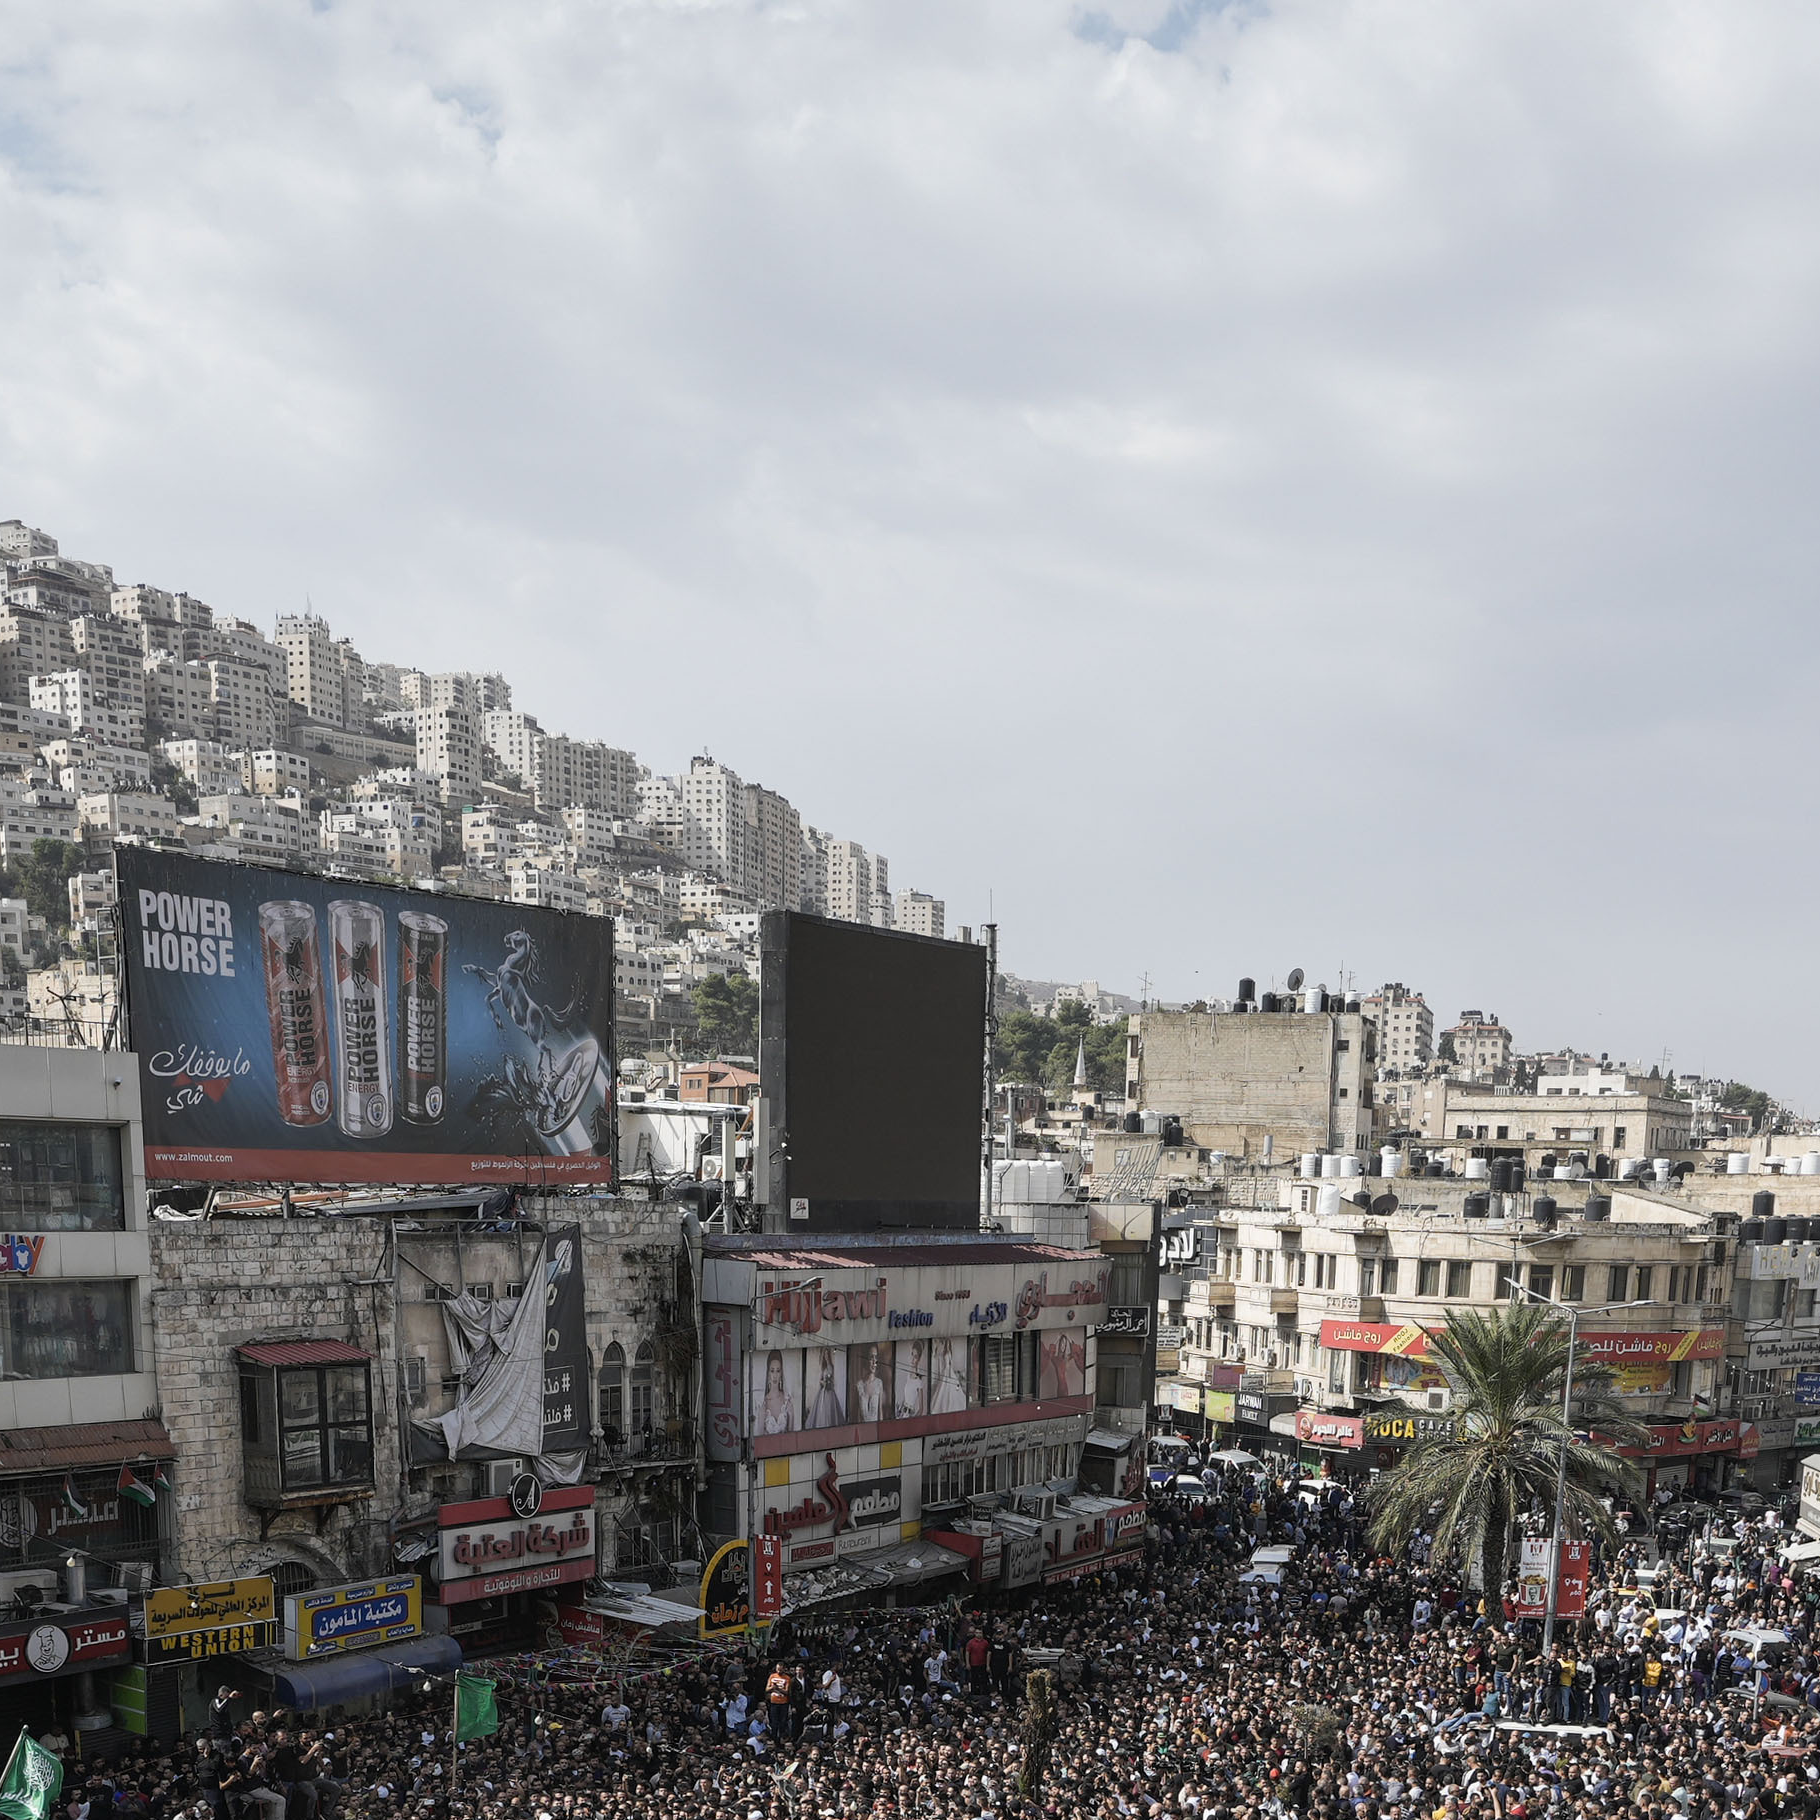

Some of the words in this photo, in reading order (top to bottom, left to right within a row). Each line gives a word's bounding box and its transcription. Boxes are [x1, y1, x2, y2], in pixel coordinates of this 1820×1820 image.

[138, 888, 233, 938] POWER
[143, 930, 235, 977] HORSE
[280, 989, 300, 1066] POWER
[295, 988, 315, 1066] HORSE
[344, 998, 362, 1082] POWER
[361, 997, 379, 1082] HORSE
[407, 996, 421, 1071] POWER
[421, 998, 436, 1073] HORSE
[347, 1083, 379, 1093] ENERGY
[155, 1152, 233, 1163] www.zalmout.com
[888, 1308, 934, 1330] Fashion
[526, 1512, 591, 1556] شركة
[318, 1608, 362, 1636] المأمون
[364, 1600, 403, 1626] مكتبة
[74, 1628, 127, 1652] مستر
[162, 1624, 256, 1650] WESTERN
[191, 1637, 256, 1659] UNION
